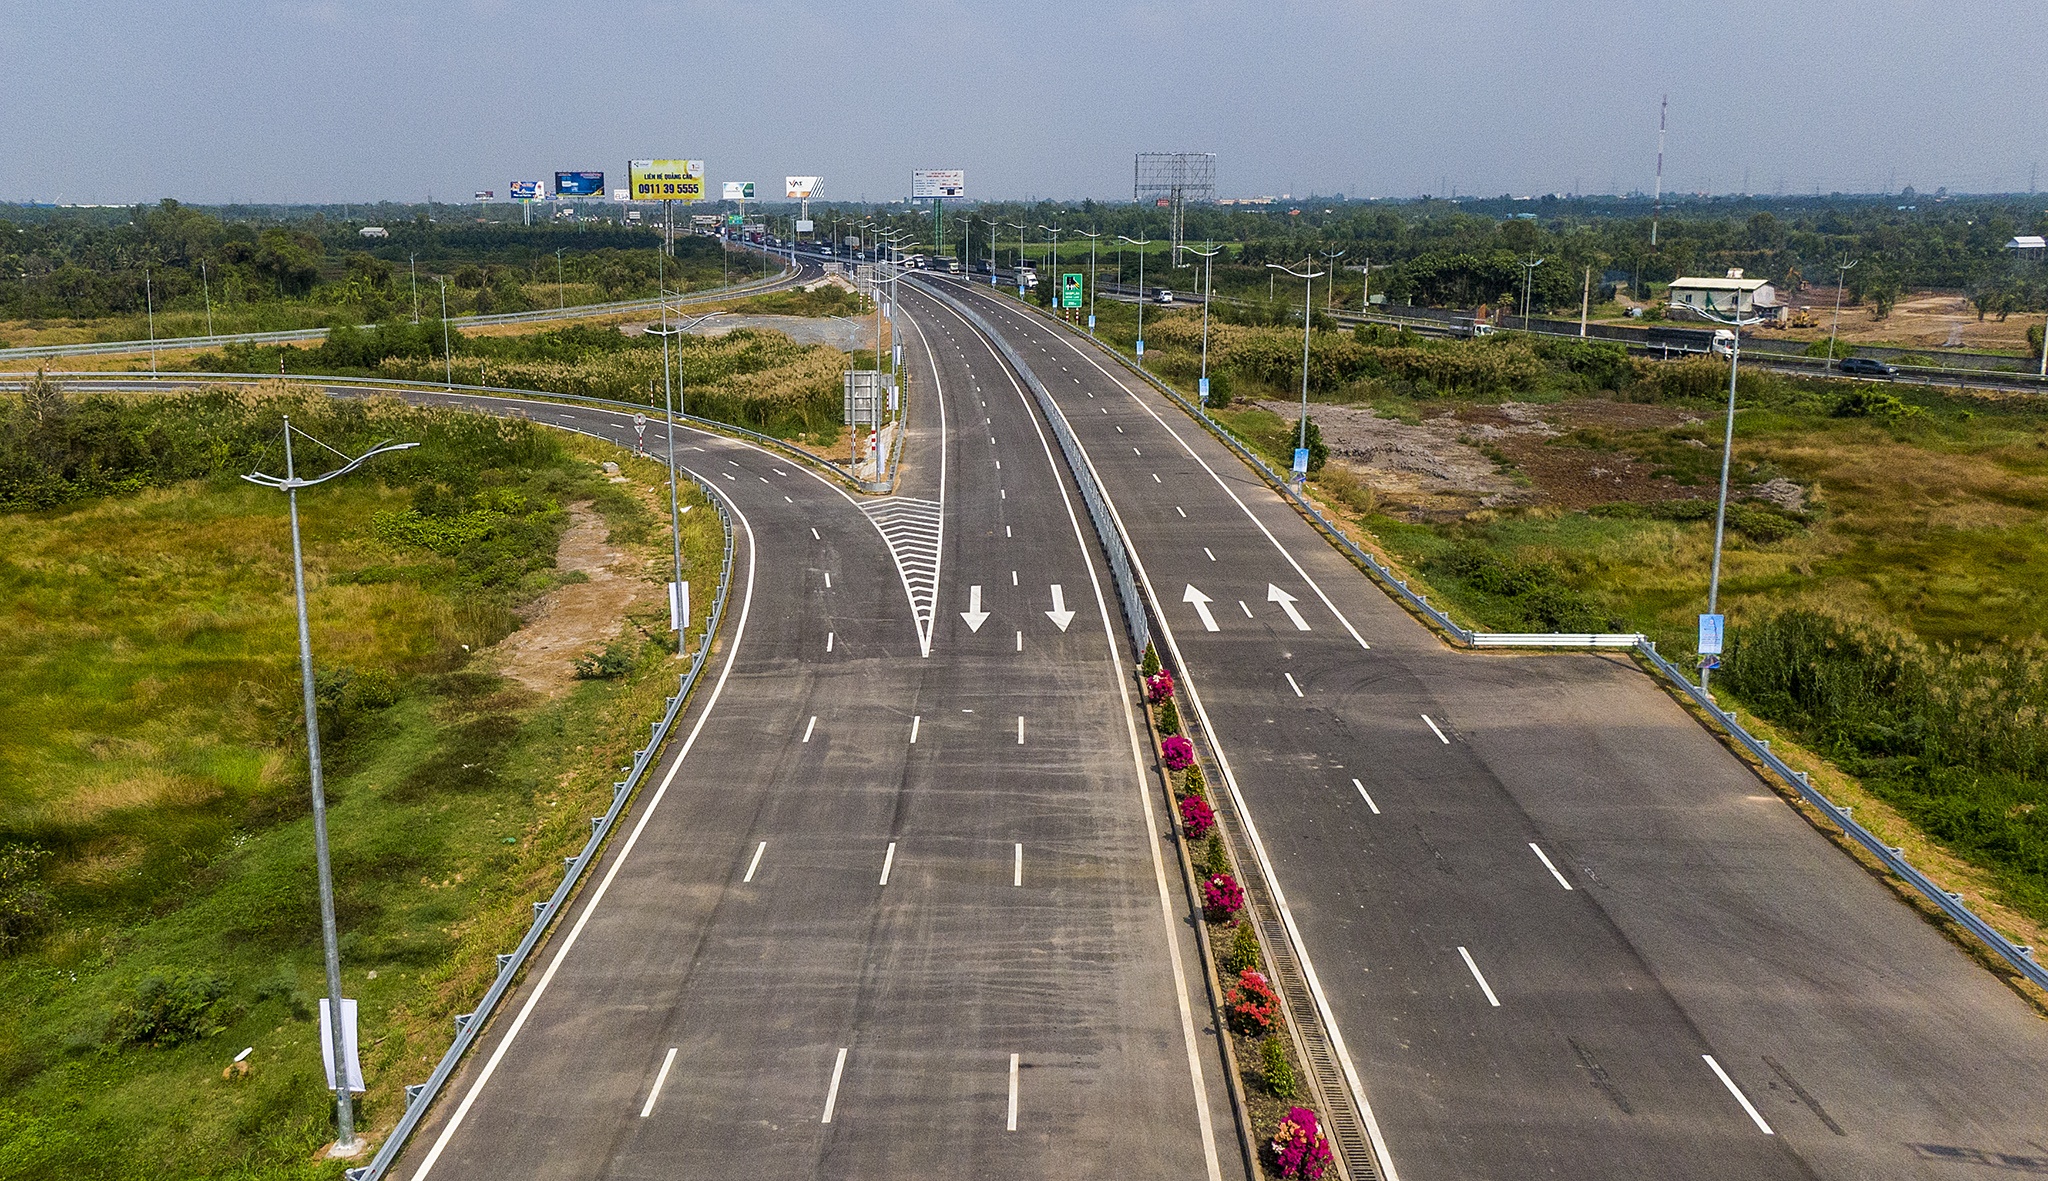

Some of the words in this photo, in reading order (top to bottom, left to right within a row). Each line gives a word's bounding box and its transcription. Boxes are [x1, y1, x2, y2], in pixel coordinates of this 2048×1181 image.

[639, 183, 660, 194] 0911
[663, 183, 674, 194] 39
[677, 183, 699, 194] 5555
